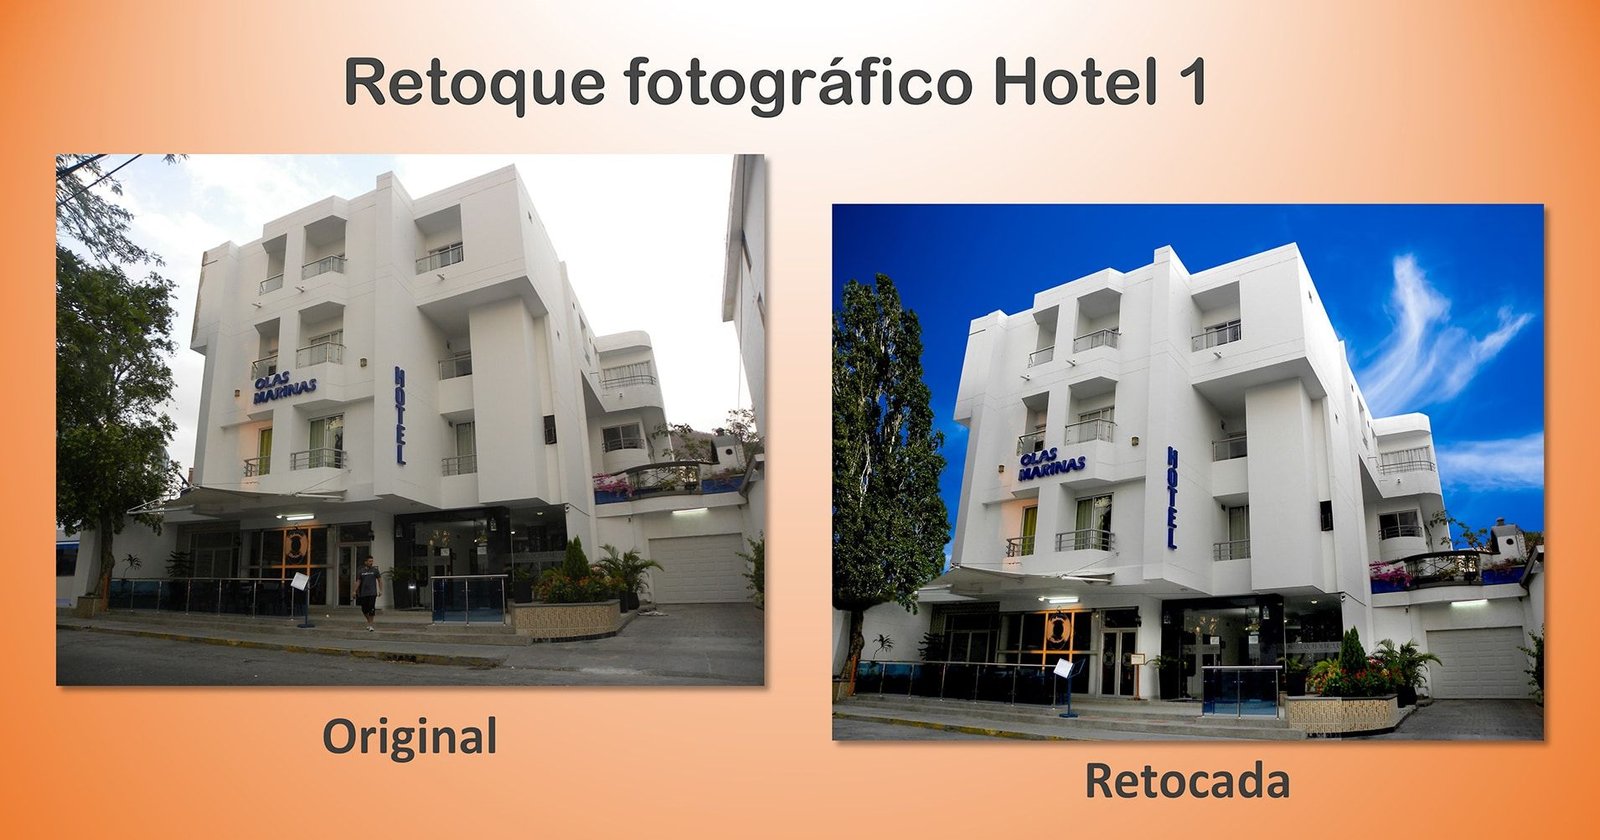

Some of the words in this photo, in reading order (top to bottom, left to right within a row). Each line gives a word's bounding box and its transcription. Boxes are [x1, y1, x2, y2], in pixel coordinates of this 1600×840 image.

[253, 379, 317, 404] MARINAS
[255, 371, 290, 390] OLAS
[395, 366, 406, 466] HOTEL
[1018, 456, 1086, 482] MARINAS
[1020, 448, 1058, 467] OLAS
[1167, 446, 1179, 550] HOTEL
